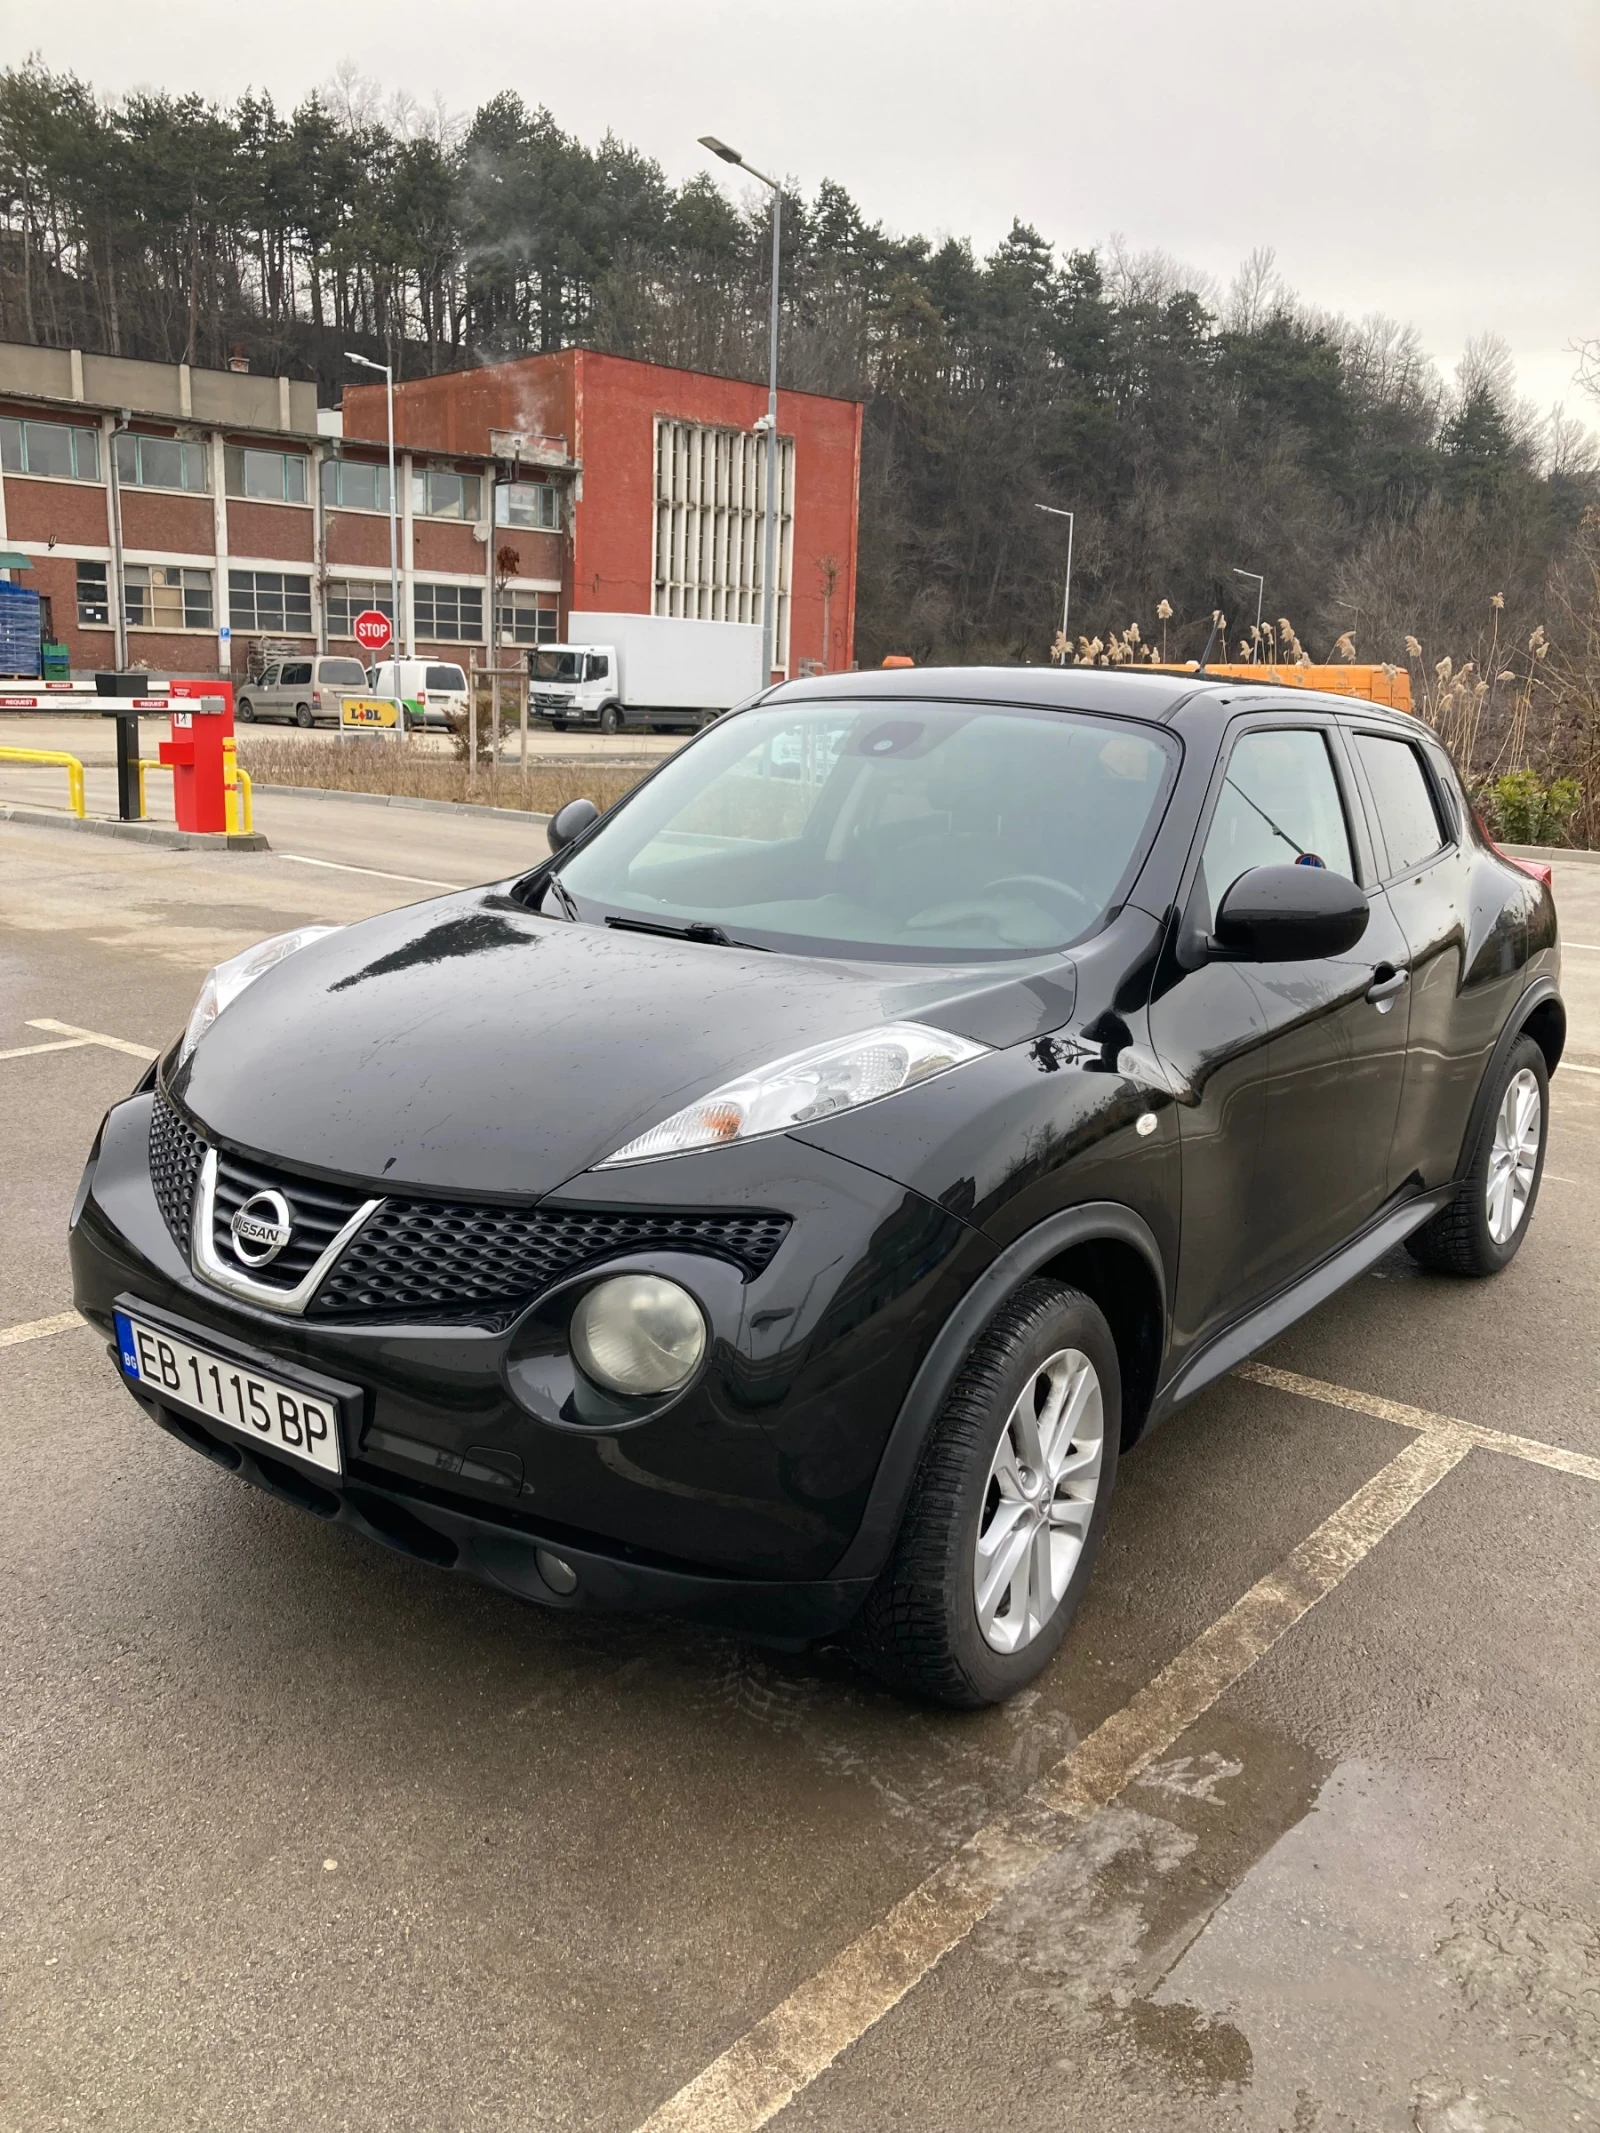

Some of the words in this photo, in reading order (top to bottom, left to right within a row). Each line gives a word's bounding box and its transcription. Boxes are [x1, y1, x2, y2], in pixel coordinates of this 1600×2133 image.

[358, 622, 388, 638] STOP
[233, 1216, 279, 1242] NISSAN
[124, 1351, 138, 1370] BG
